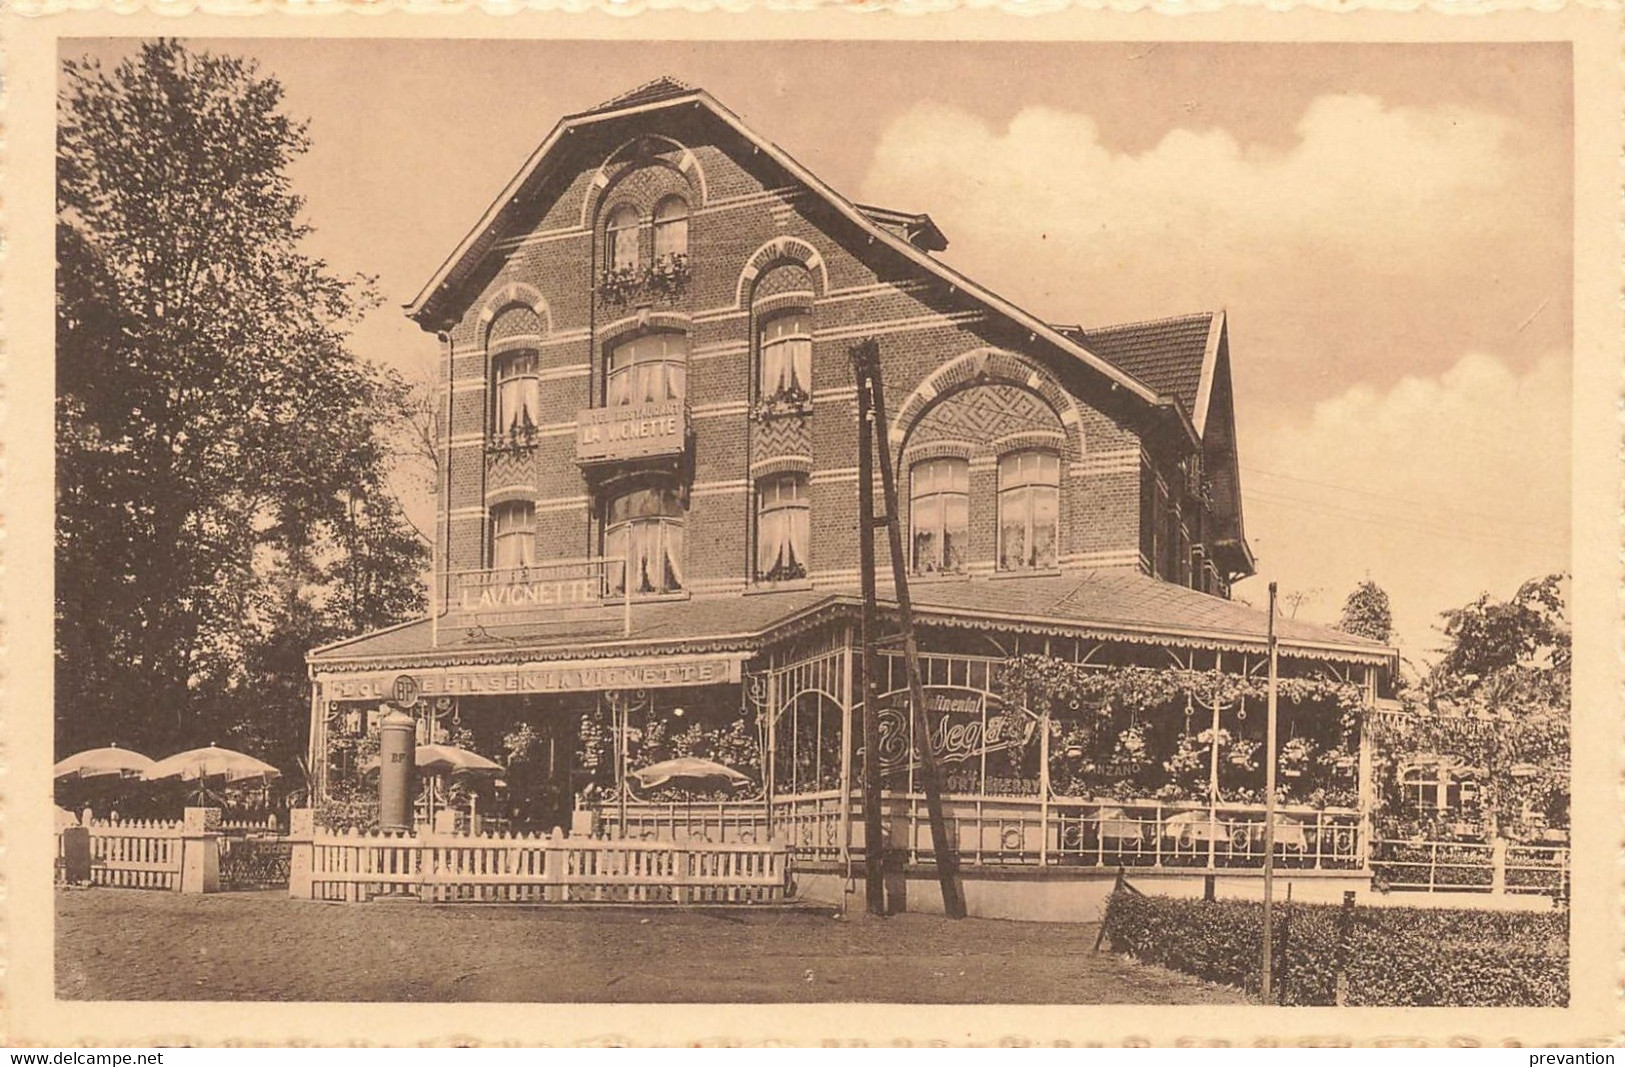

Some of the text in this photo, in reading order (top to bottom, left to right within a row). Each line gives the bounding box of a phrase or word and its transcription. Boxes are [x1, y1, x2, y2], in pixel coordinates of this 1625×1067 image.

[577, 664, 713, 689] VIGNETTE
[396, 681, 414, 702] BP
[391, 753, 407, 763] BP
